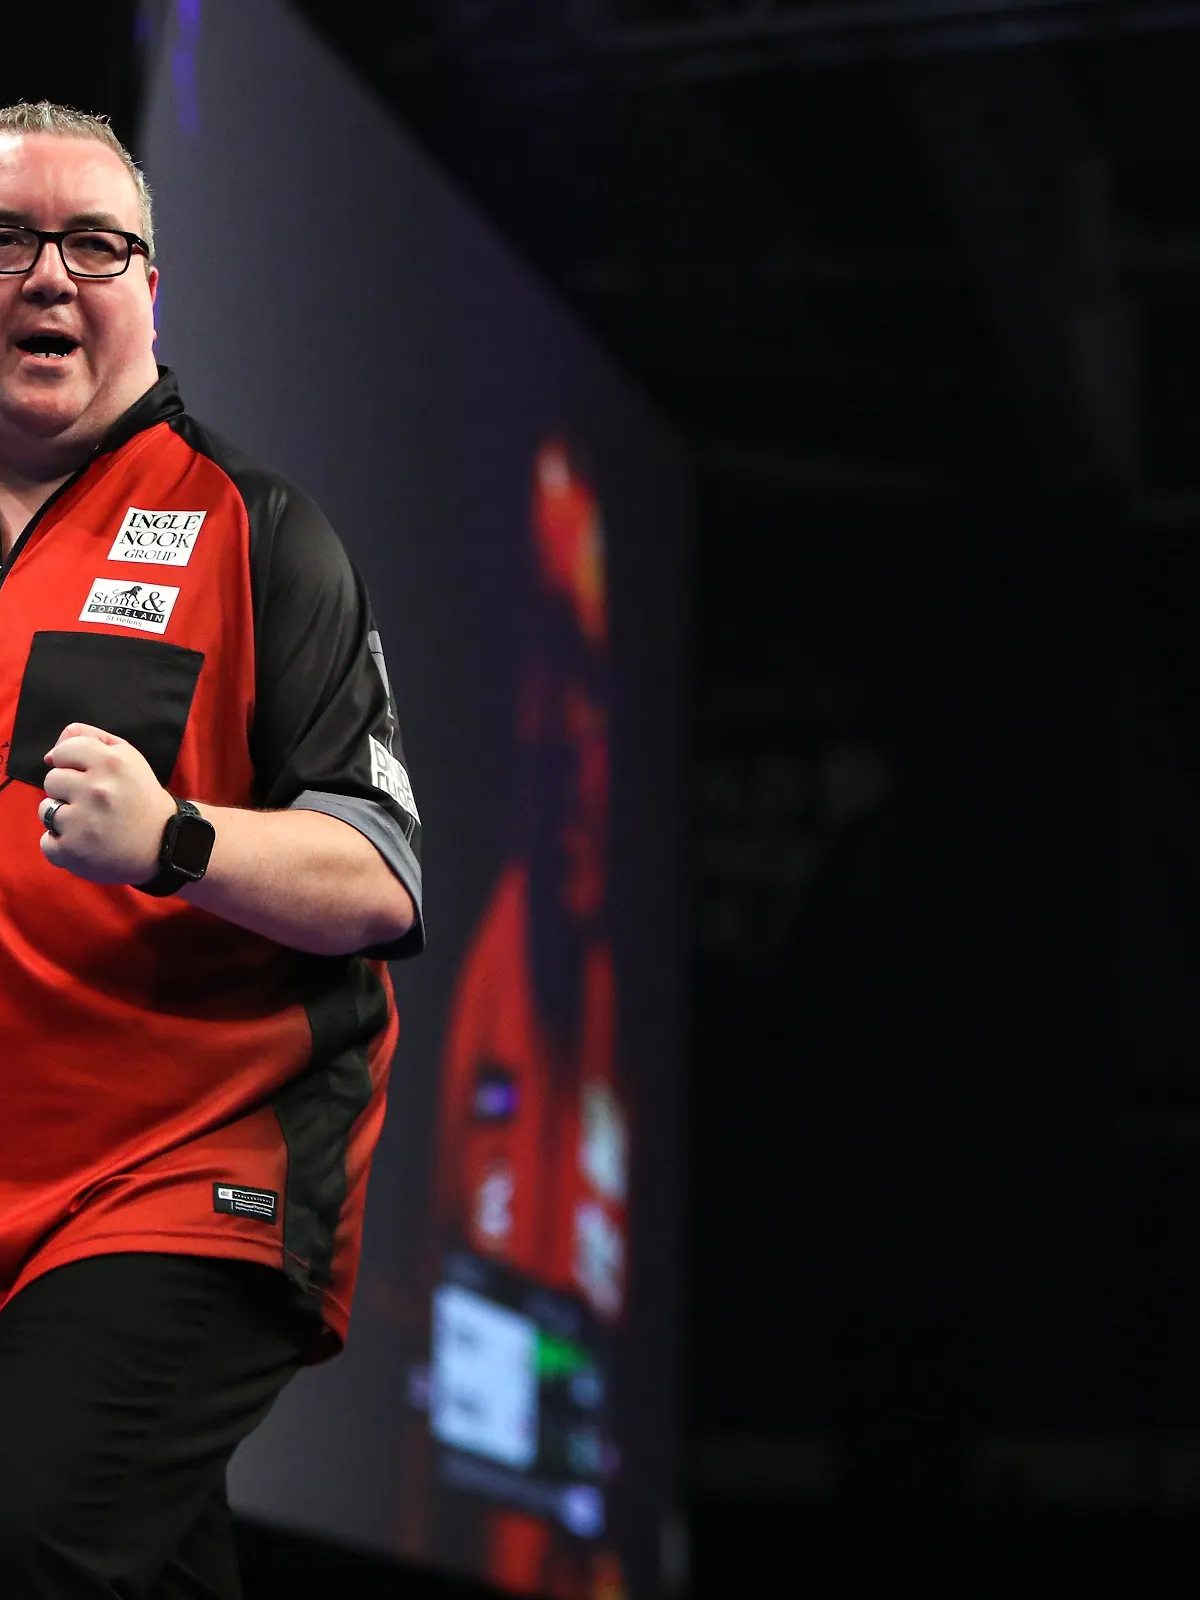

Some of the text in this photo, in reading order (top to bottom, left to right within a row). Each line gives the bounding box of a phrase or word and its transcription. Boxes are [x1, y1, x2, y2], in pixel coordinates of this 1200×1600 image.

[128, 512, 201, 531] INGLE
[119, 530, 194, 549] NOOK
[124, 548, 177, 561] GROUP
[91, 591, 167, 613] Stone &
[89, 604, 164, 623] PORCELAIN
